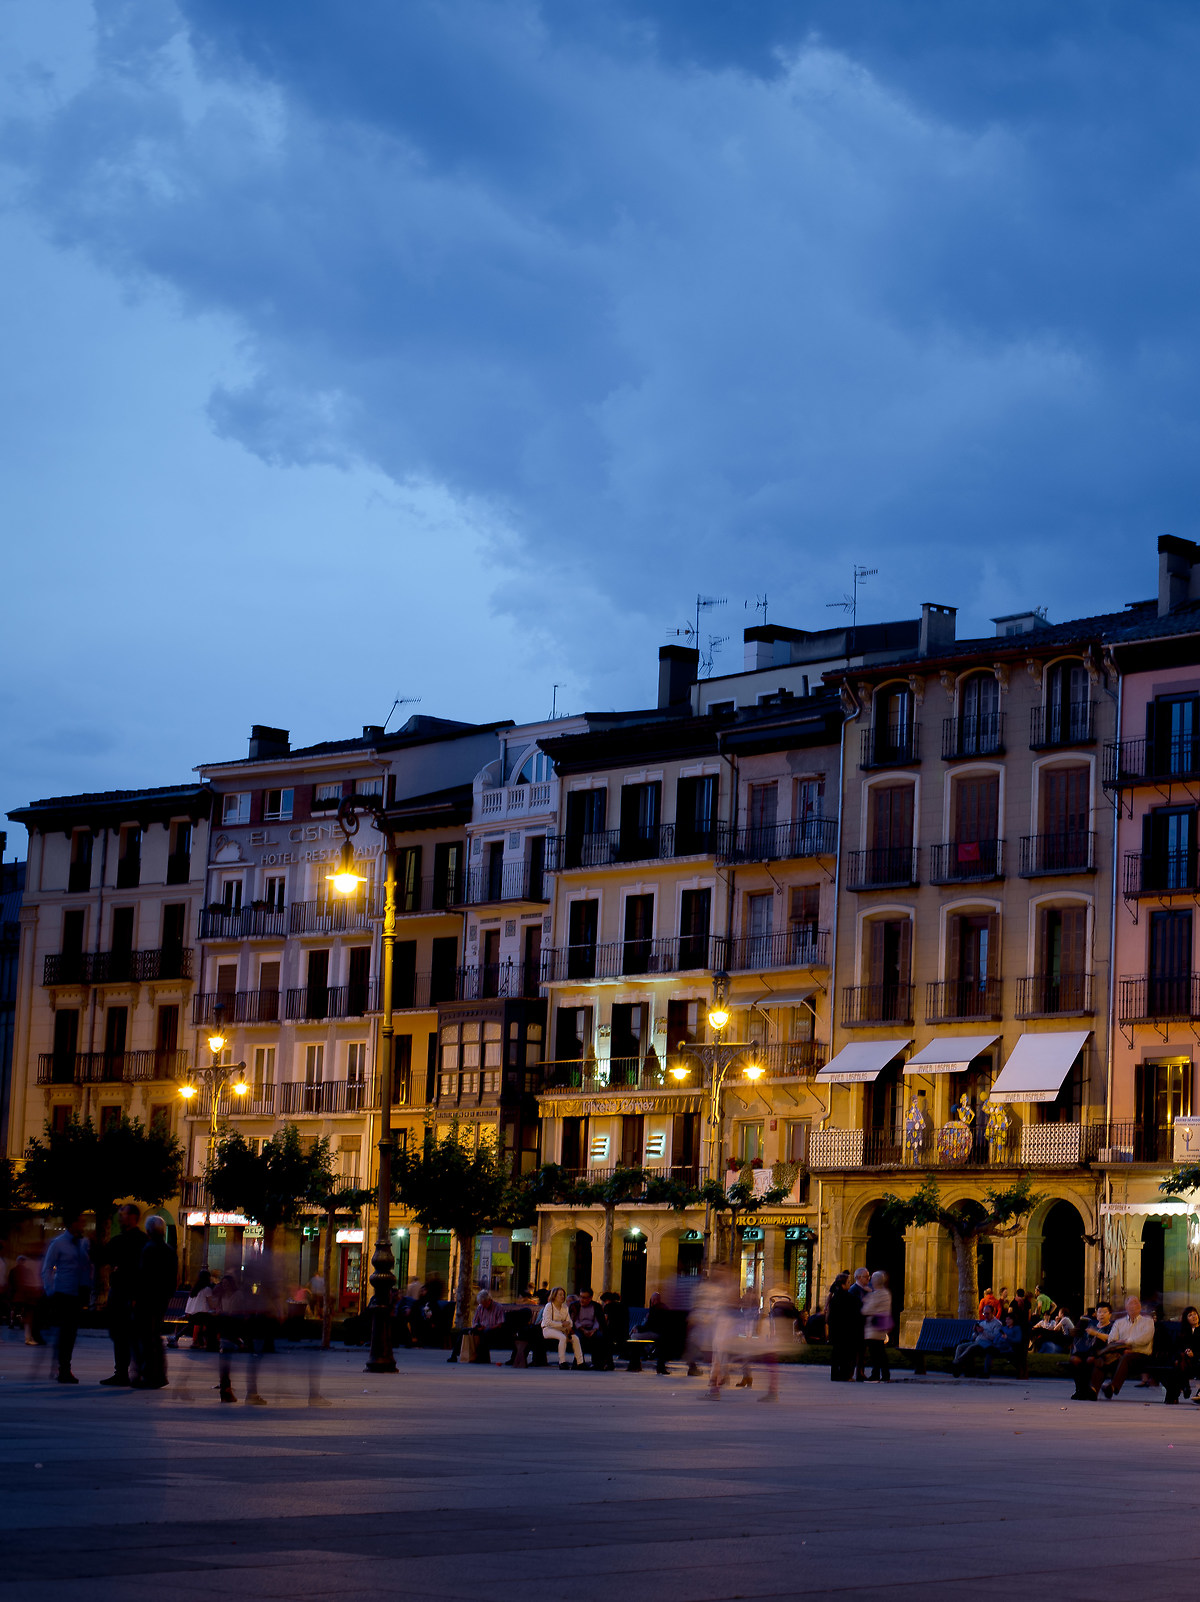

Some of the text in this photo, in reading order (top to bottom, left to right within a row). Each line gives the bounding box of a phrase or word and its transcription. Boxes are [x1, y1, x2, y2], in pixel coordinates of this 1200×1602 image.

[250, 823, 346, 846] EL CISNE
[261, 851, 298, 866] HOTEL
